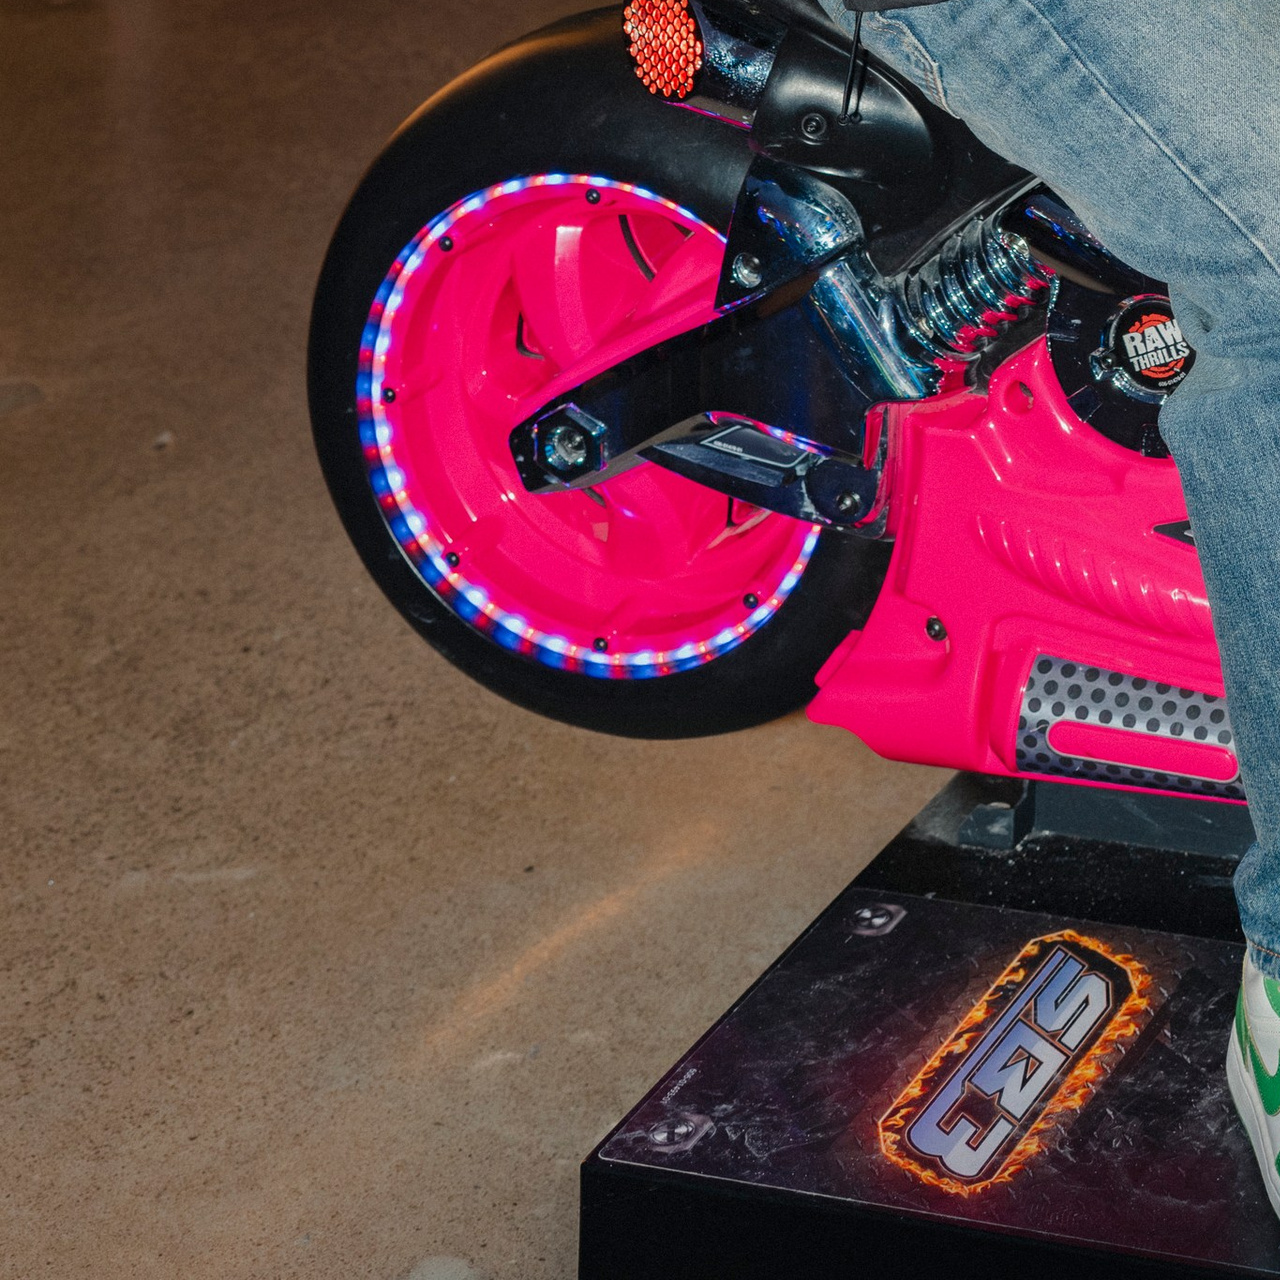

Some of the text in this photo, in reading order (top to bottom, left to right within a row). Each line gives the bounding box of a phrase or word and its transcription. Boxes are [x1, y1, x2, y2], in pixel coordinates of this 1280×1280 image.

[1122, 318, 1183, 358] RAW
[1129, 340, 1190, 373] THRILLS
[906, 946, 1113, 1180] SB3
